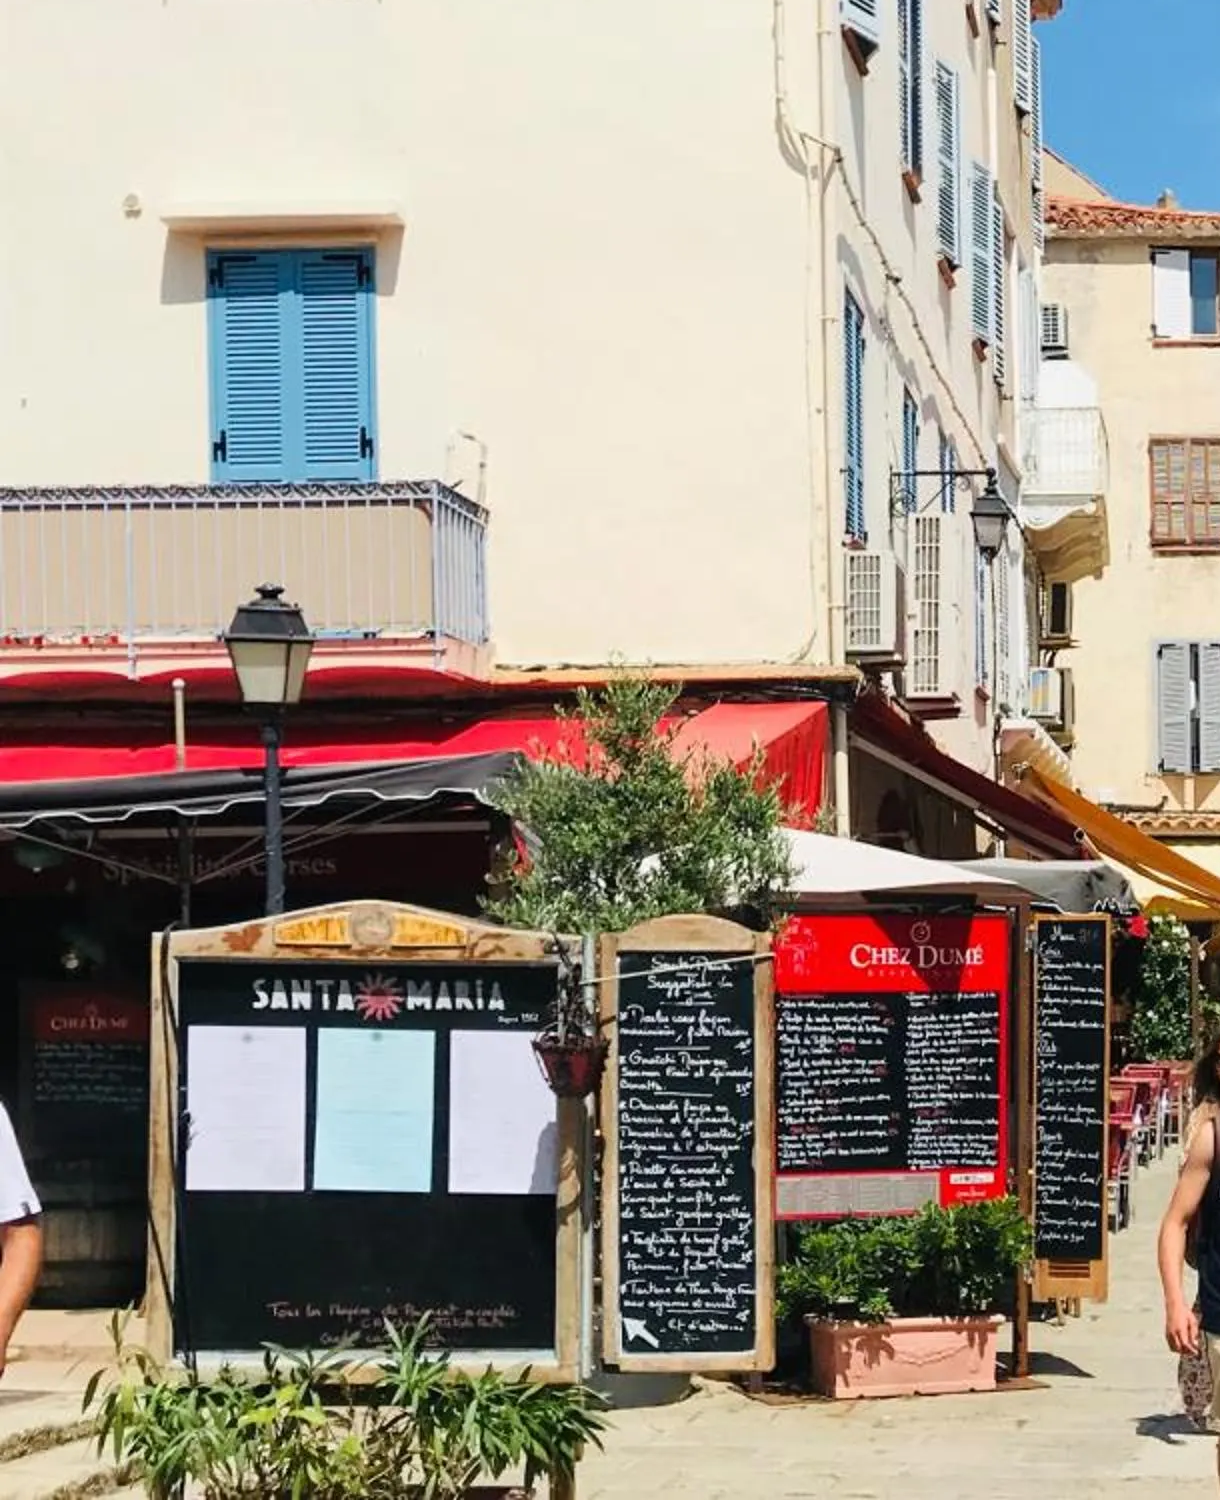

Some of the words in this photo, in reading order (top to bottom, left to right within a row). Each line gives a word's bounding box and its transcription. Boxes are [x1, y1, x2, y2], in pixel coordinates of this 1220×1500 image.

[249, 854, 338, 878] Crses
[850, 943, 911, 969] CHEZ
[917, 943, 985, 969] DUMÉ
[251, 979, 356, 1011] SANTA
